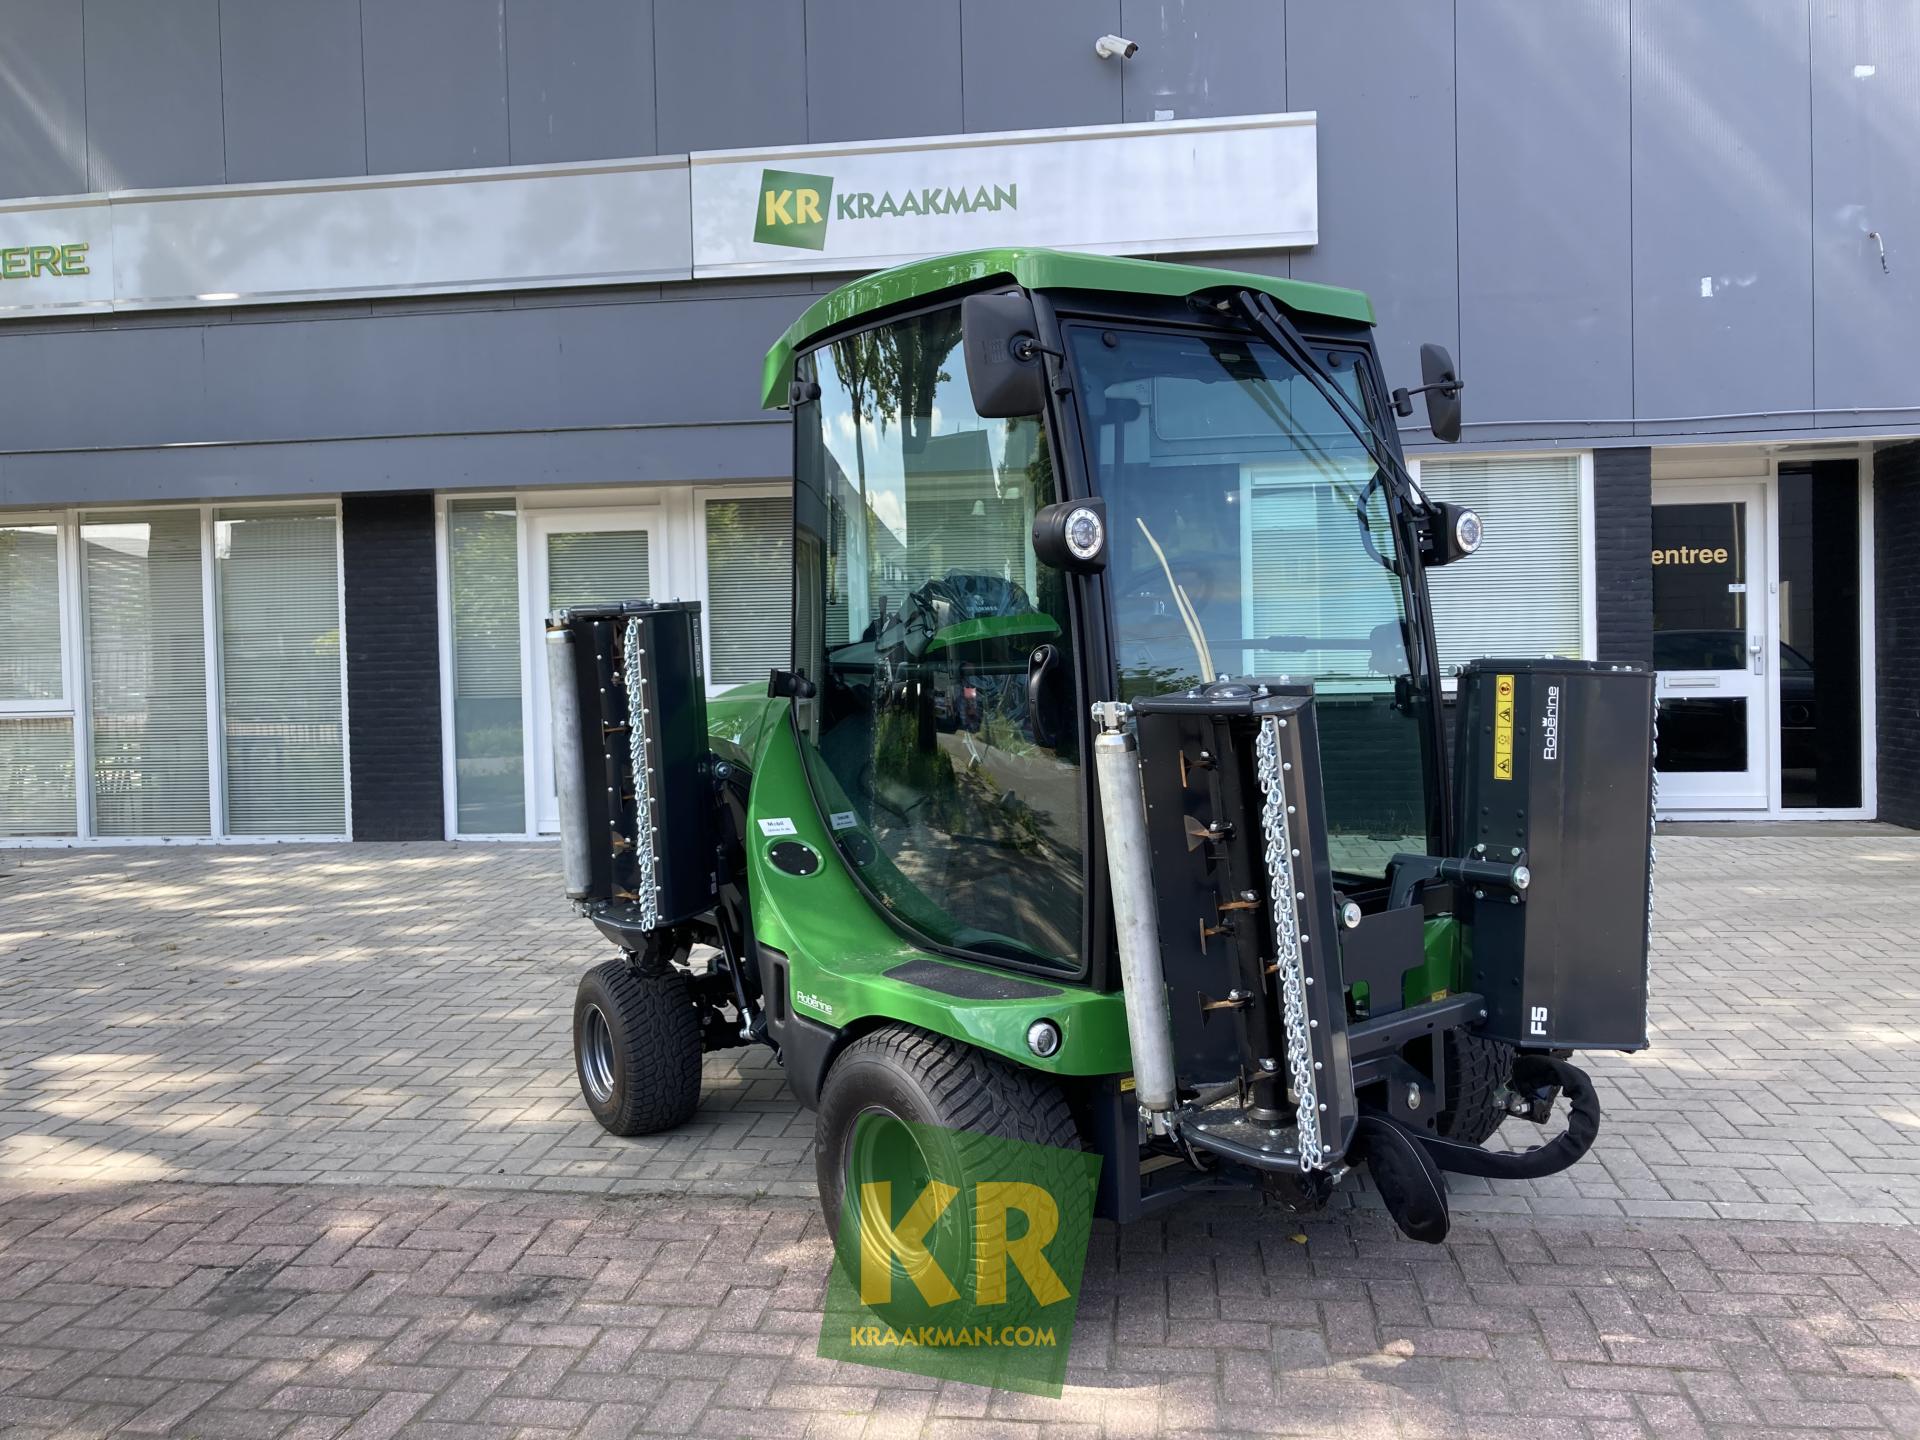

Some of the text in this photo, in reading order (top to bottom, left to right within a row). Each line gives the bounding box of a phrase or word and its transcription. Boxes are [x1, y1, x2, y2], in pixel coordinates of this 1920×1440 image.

[765, 183, 1017, 226] KR KRAAKMAN
[0, 242, 90, 280] ERE
[1651, 545, 1729, 565] entree
[1542, 686, 1559, 760] Roberine
[796, 990, 833, 1016] Roberine
[1530, 1006, 1548, 1035] F5
